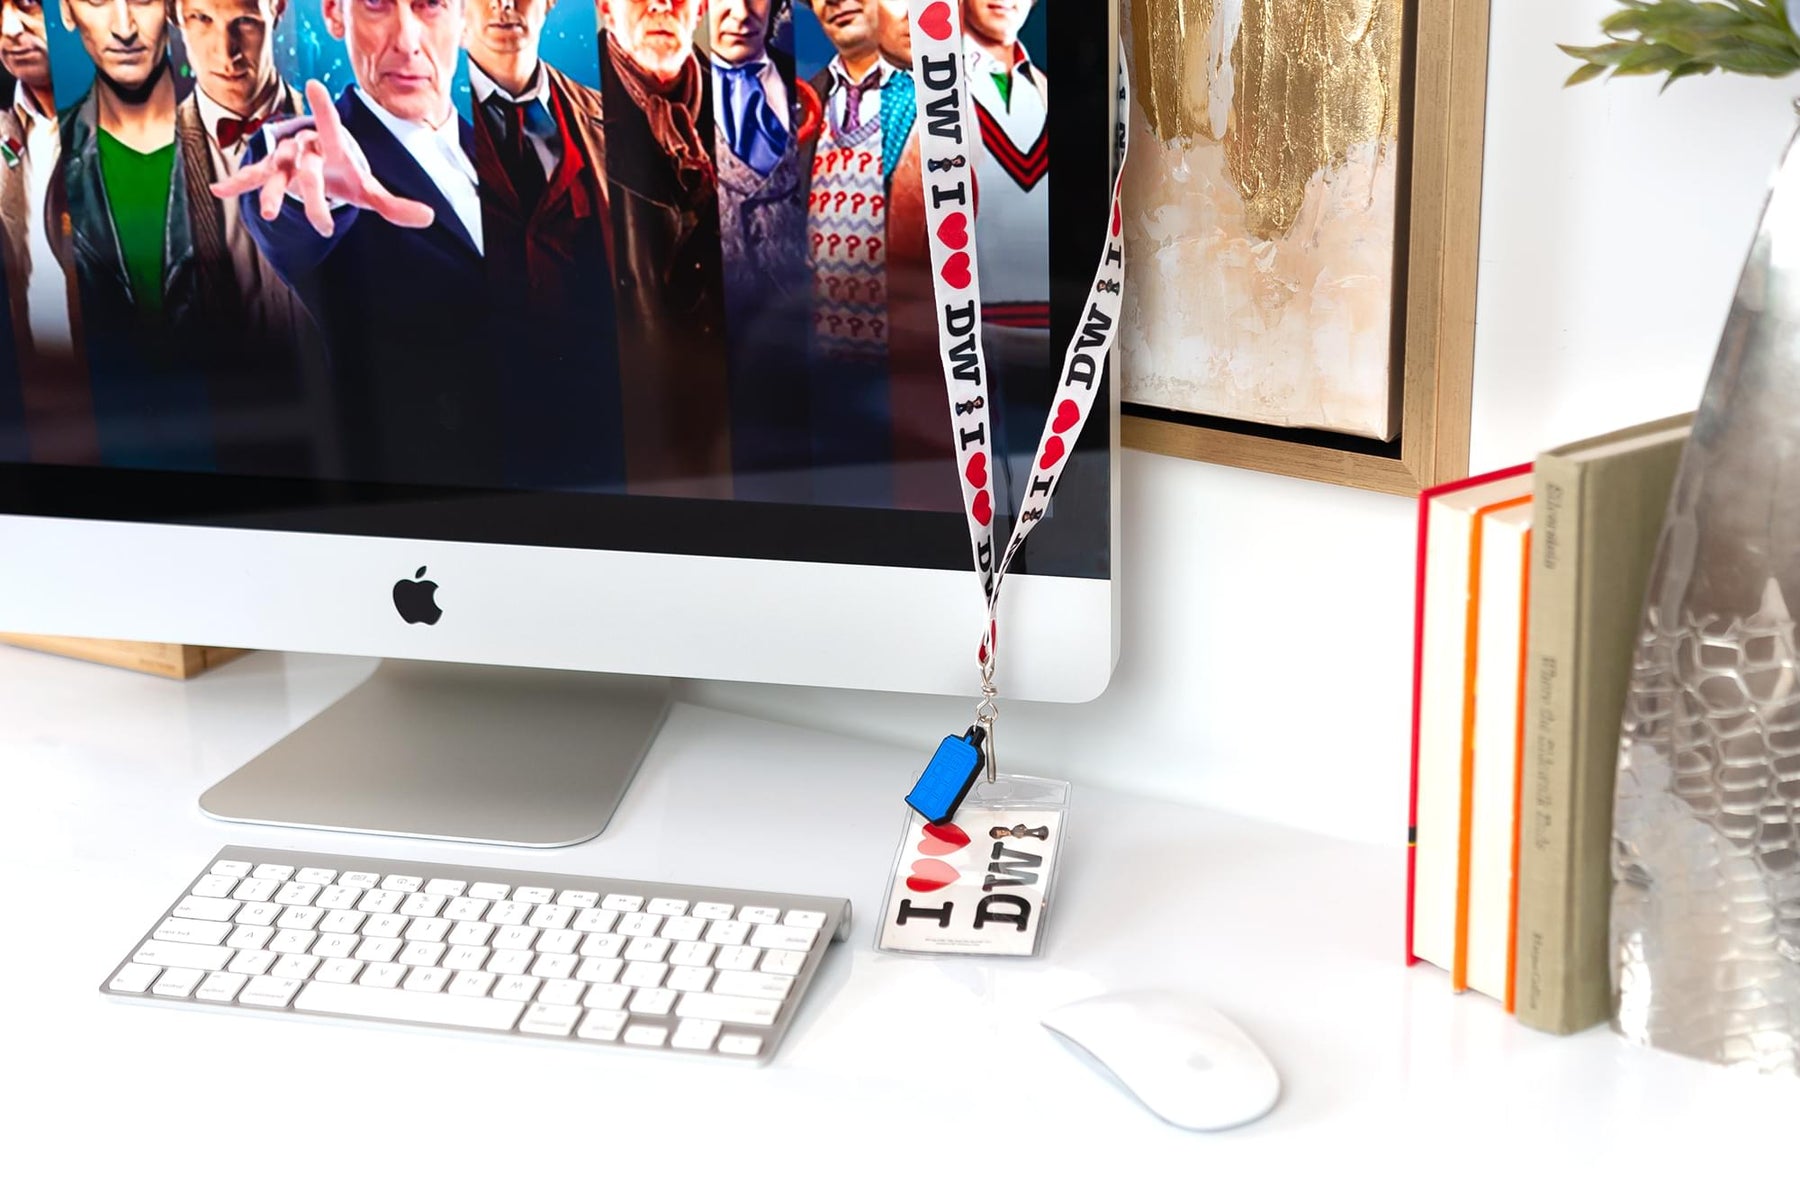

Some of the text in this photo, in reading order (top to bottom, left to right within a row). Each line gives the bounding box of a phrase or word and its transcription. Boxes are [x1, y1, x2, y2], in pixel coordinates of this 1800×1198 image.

[921, 53, 963, 144] DW
[932, 181, 966, 209] I
[945, 299, 981, 386] DW
[1029, 242, 1122, 498] I DW I
[960, 421, 985, 452] I
[896, 898, 954, 929] I
[973, 841, 1043, 932] DW
